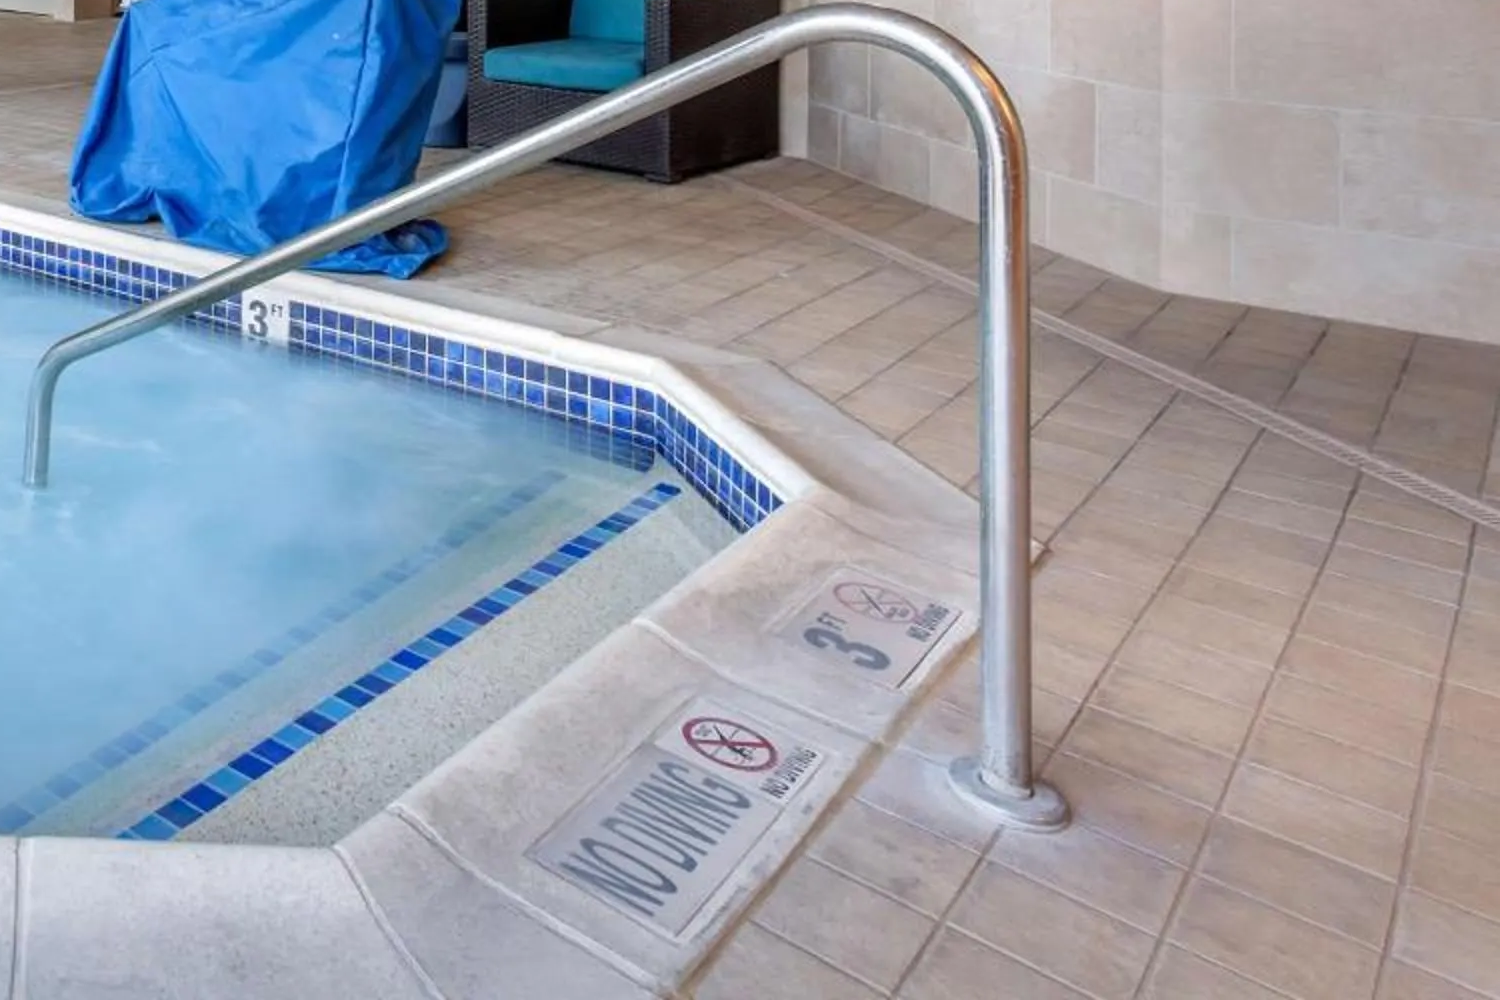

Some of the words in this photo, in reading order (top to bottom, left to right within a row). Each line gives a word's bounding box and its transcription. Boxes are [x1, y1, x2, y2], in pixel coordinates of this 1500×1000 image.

[802, 626, 892, 671] 3
[600, 760, 753, 873] DIVING
[560, 836, 678, 918] NO
